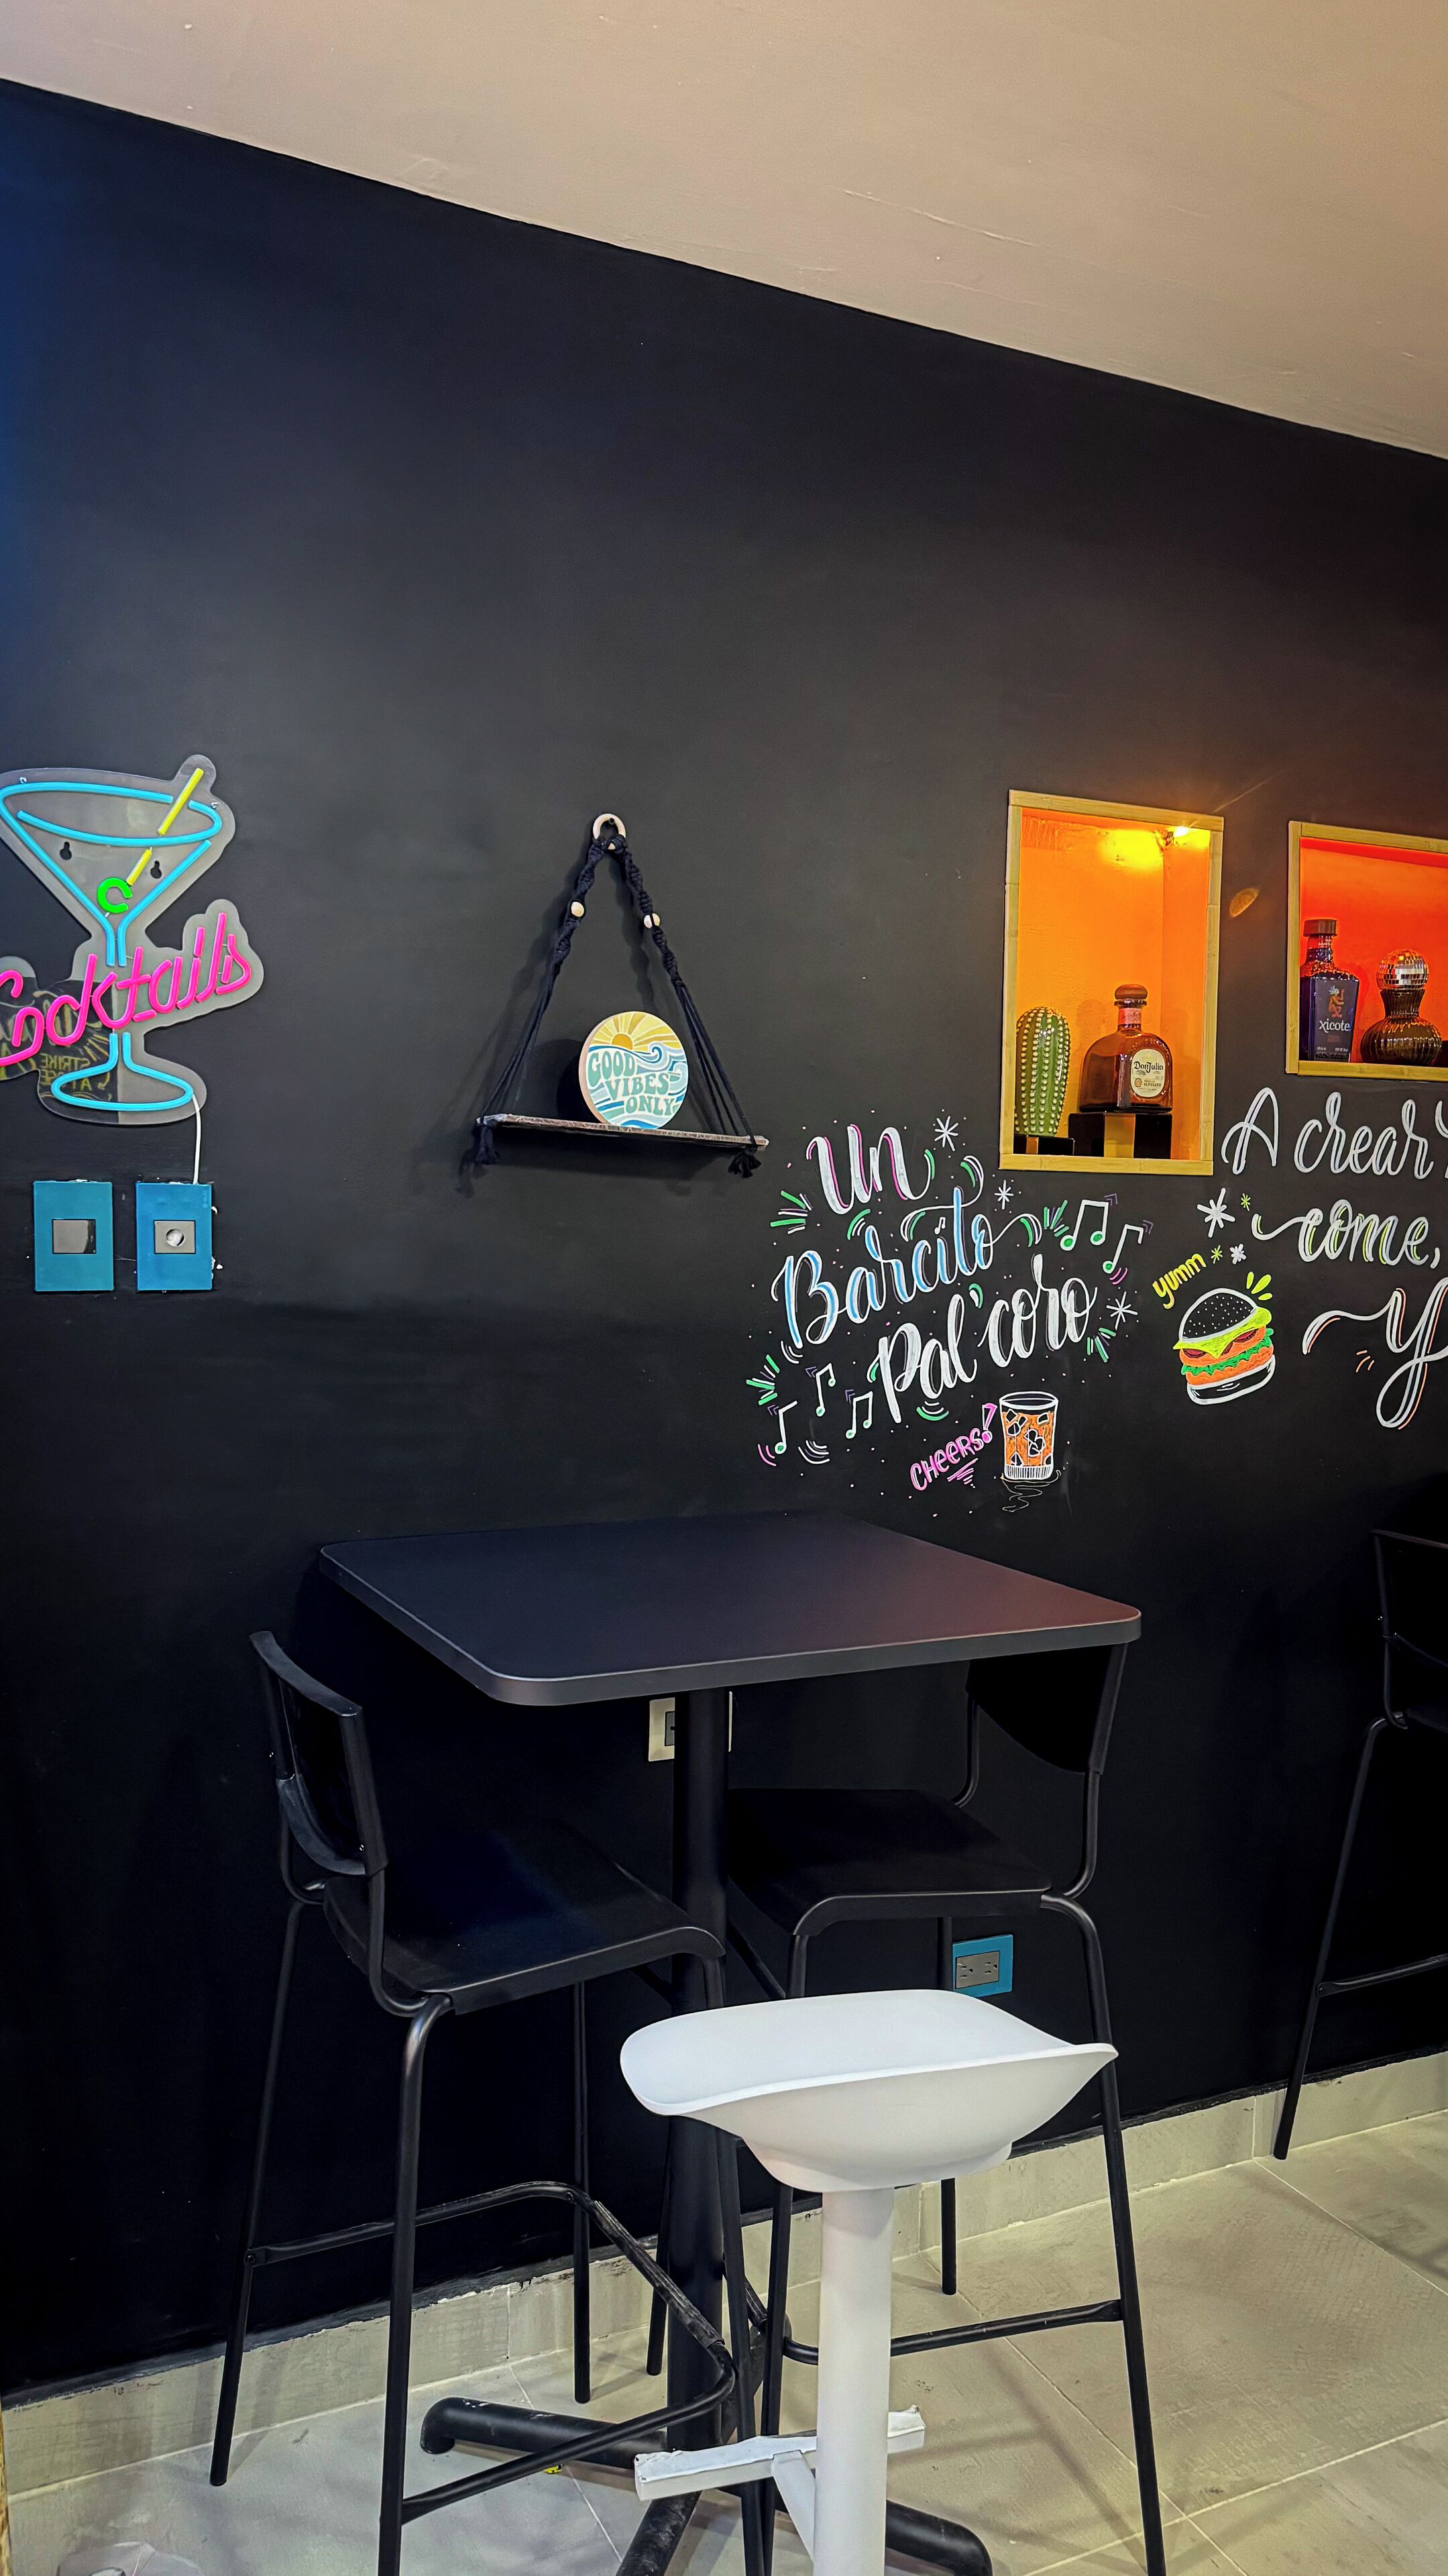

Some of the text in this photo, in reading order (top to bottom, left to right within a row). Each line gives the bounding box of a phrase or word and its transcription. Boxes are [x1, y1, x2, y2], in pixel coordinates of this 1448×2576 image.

[588, 1051, 635, 1087] GOOD
[605, 1073, 669, 1101] VIBES
[625, 1095, 675, 1116] ONLY
[1221, 1087, 1278, 1175] A
[771, 1156, 1042, 1348] Barcito
